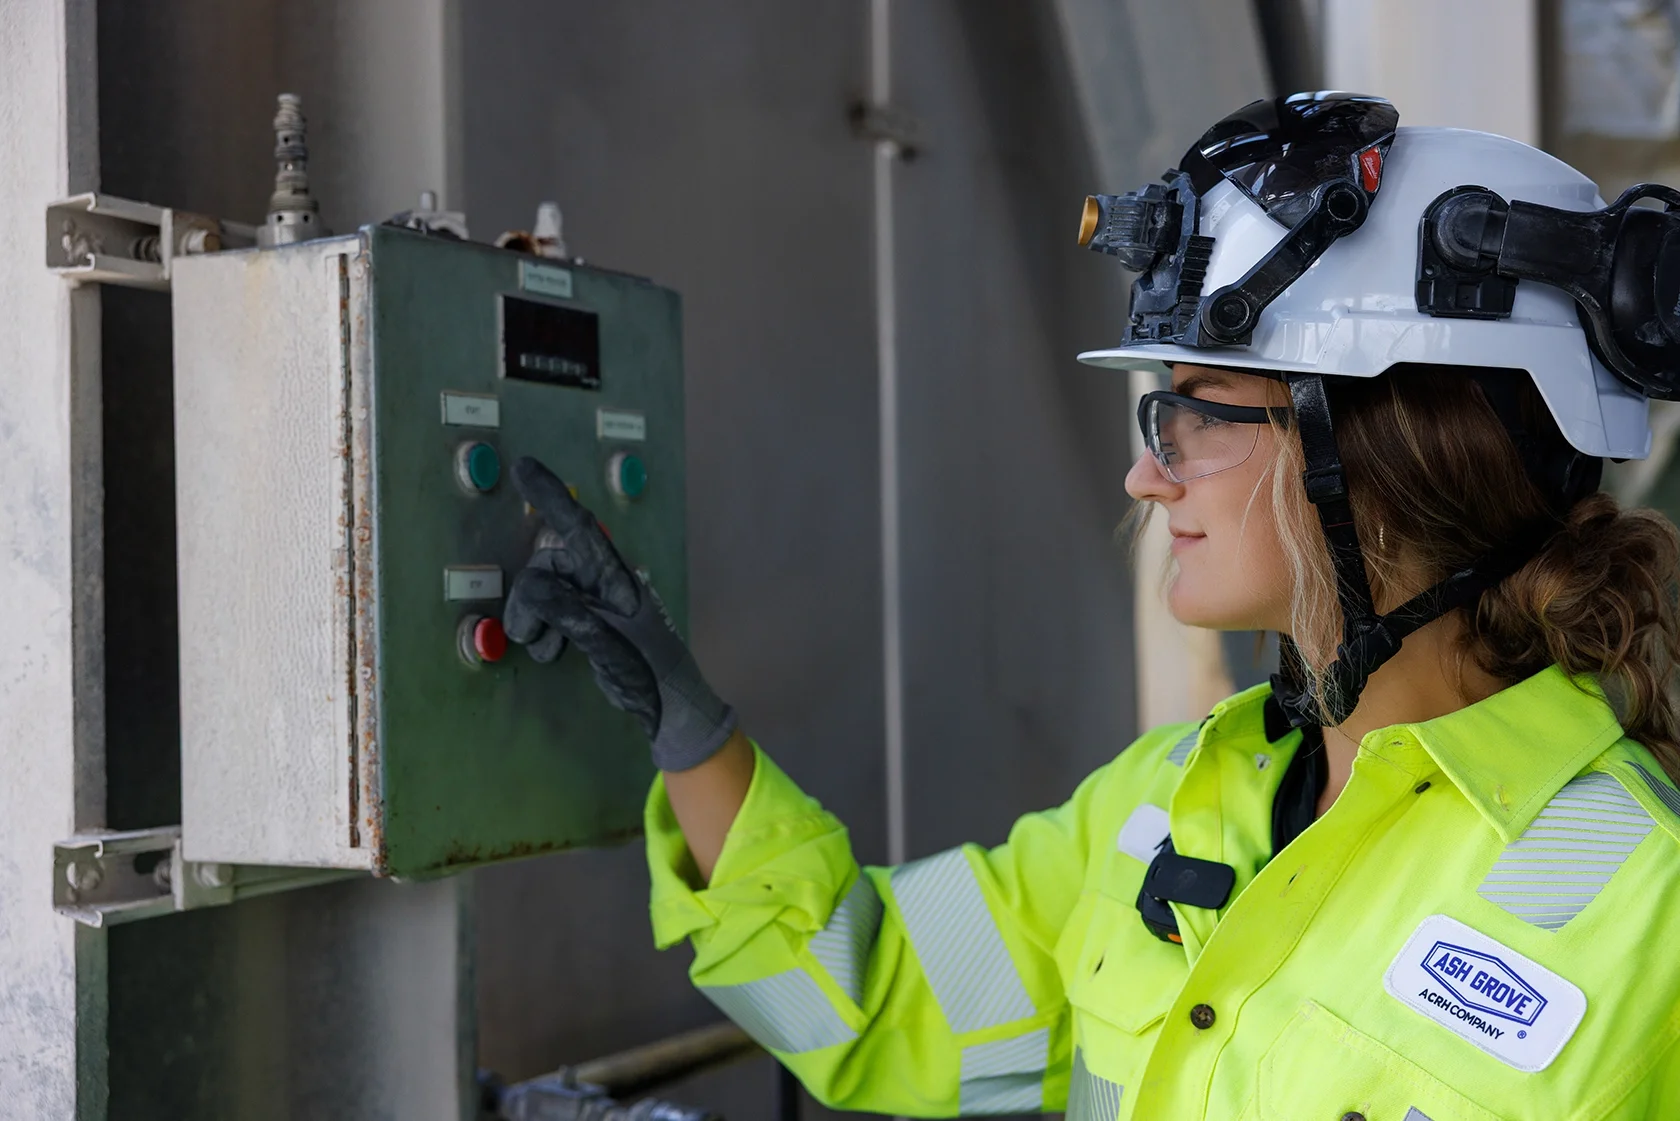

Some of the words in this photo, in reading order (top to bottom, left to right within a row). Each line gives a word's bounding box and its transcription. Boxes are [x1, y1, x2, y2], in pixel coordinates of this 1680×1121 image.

[1433, 952, 1474, 983] ASH
[1469, 970, 1533, 1016] GROVE
[1449, 1004, 1505, 1040] COMPANY
